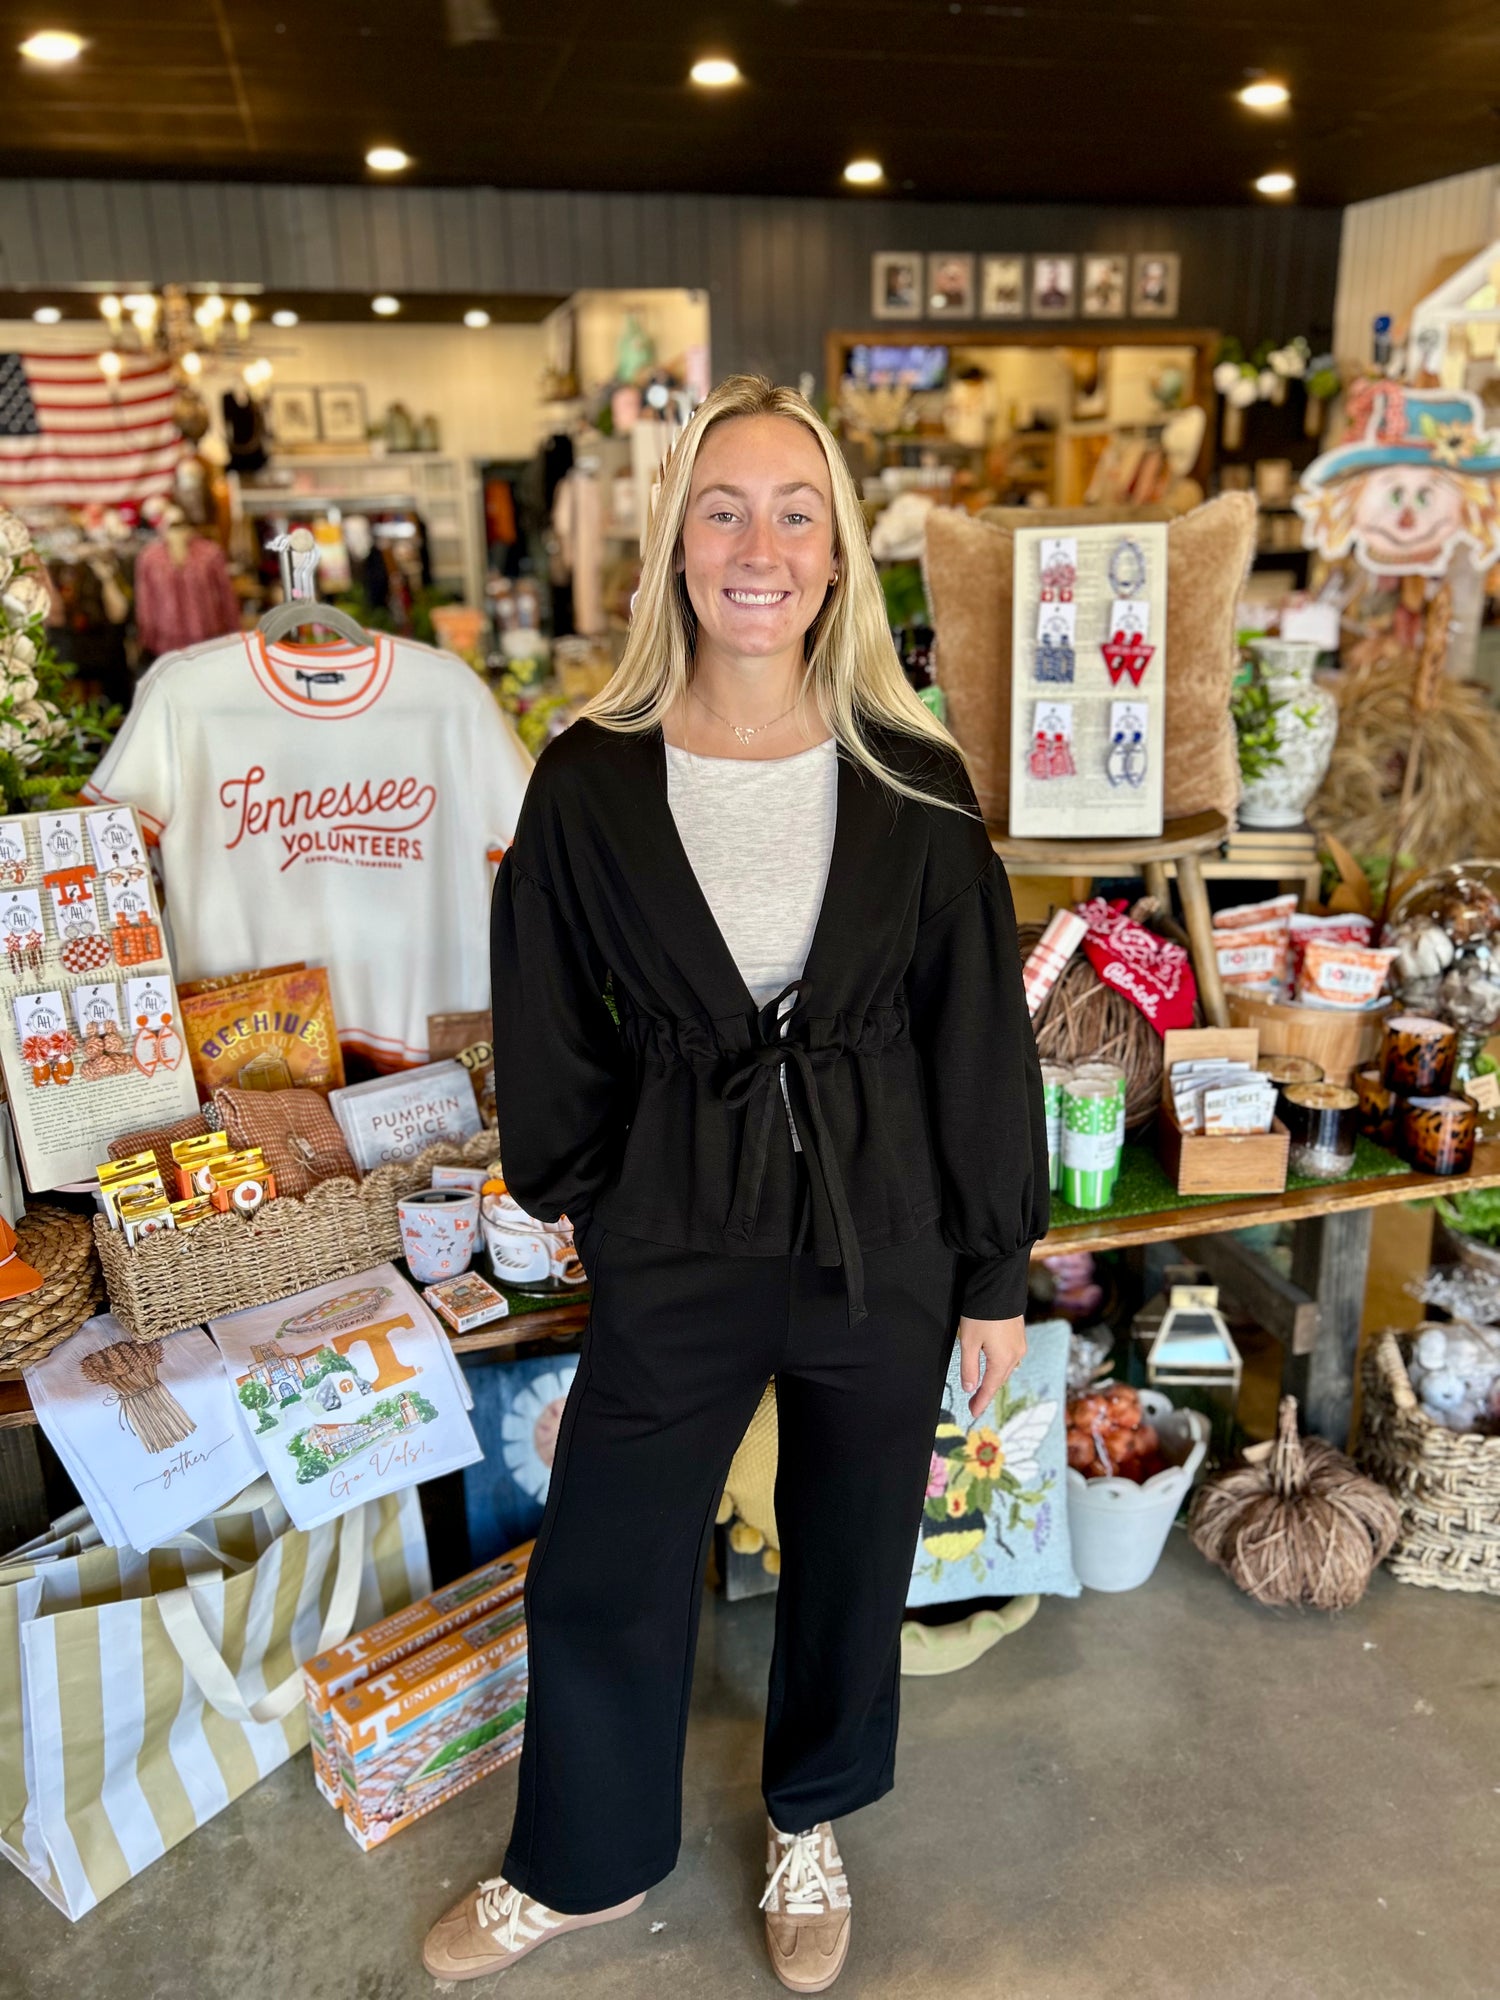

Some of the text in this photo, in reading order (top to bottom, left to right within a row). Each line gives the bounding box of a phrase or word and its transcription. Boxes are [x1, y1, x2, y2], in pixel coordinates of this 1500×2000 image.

[220, 766, 436, 849] Tennessee
[281, 831, 423, 866] VOLUNTEERS
[13, 912, 27, 926] AH
[37, 1015, 51, 1029] AH
[372, 1096, 459, 1131] PUMPKIN
[403, 1095, 421, 1106] THE
[393, 1116, 447, 1143] SPICE
[331, 1313, 415, 1393] T
[330, 1440, 425, 1498] Go Vols!
[371, 1619, 456, 1671] UNIVERSITY
[455, 1609, 472, 1624] OF
[403, 1656, 489, 1709] UNIVERSITY
[489, 1645, 506, 1661] OF
